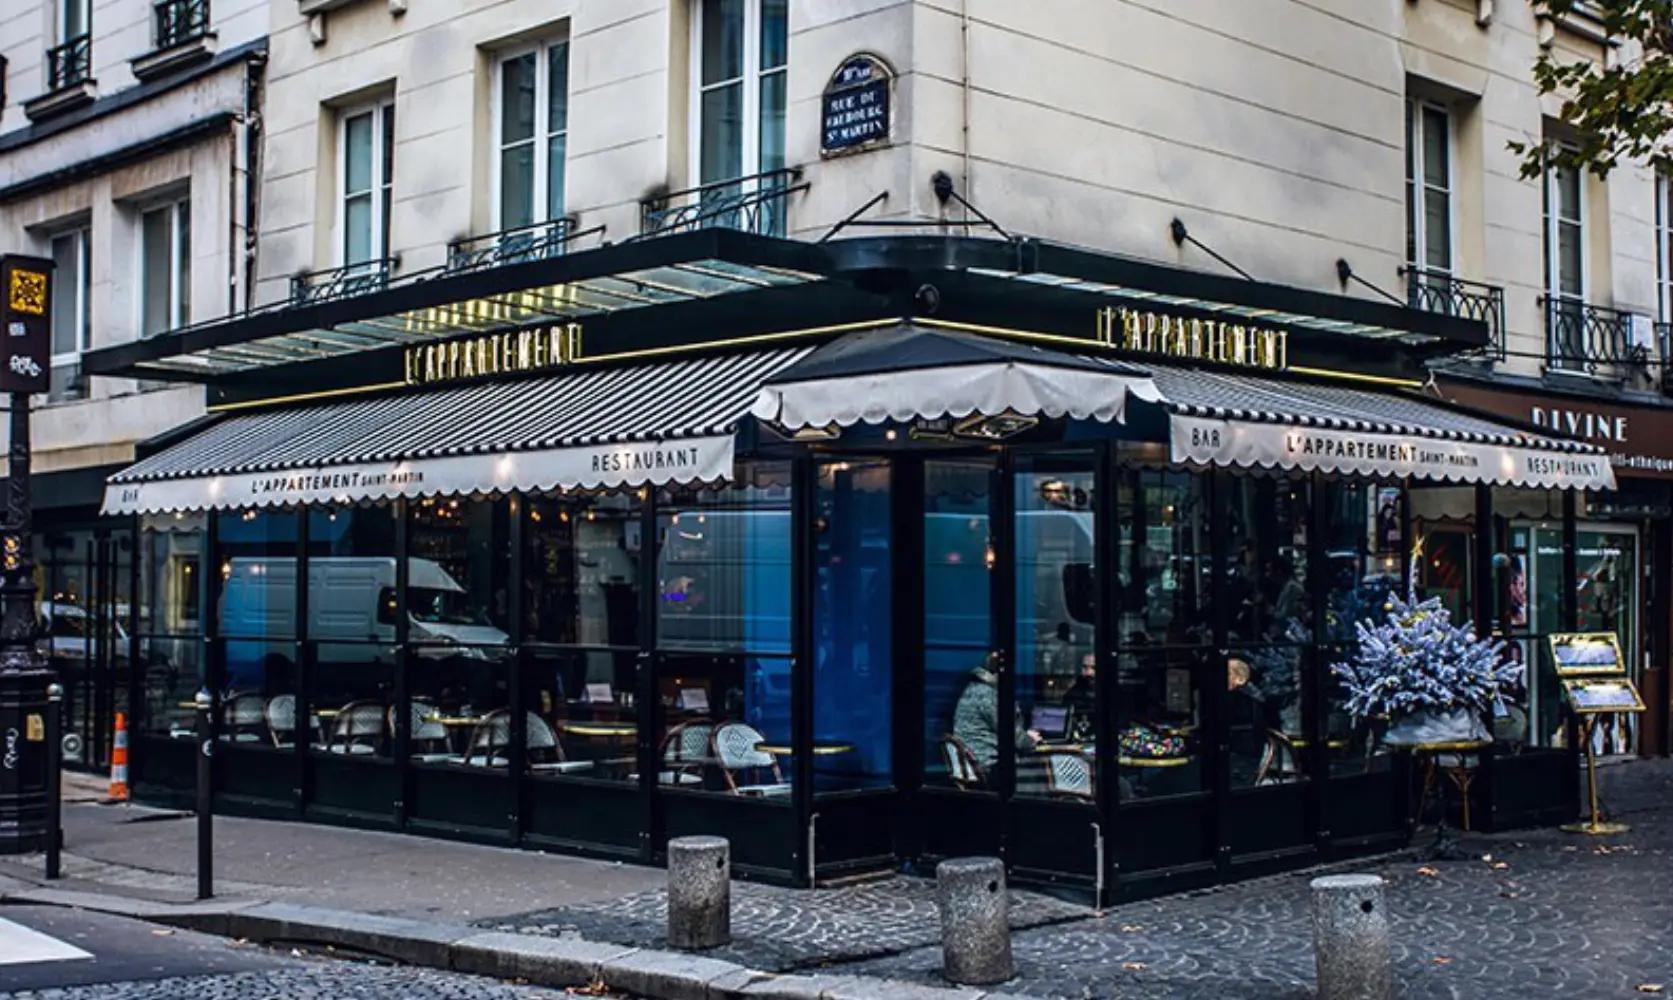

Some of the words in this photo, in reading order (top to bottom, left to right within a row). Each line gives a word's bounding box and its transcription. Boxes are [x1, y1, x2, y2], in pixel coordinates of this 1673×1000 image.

[1192, 428, 1220, 447] BAR
[592, 448, 698, 471] RESTAURANT
[1287, 436, 1416, 462] L'APPARTEMENT
[1527, 457, 1599, 477] RESTAURANT
[252, 472, 359, 494] L'APPARTEMENT
